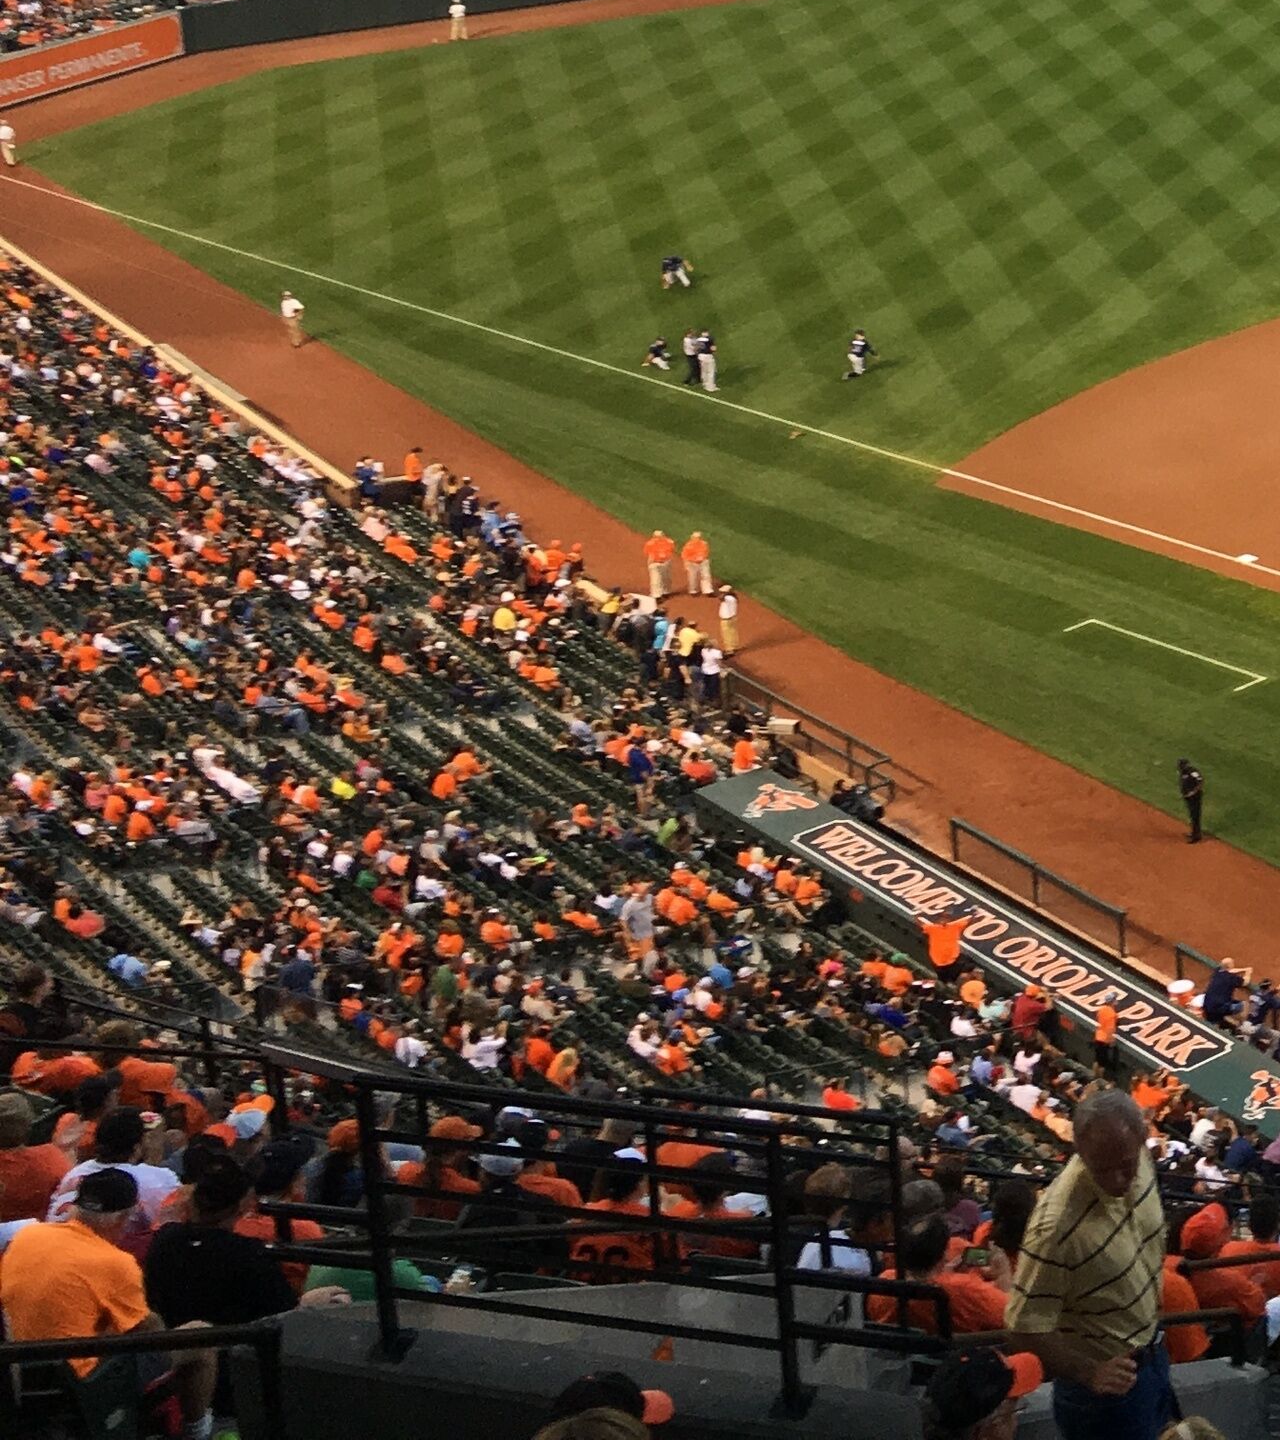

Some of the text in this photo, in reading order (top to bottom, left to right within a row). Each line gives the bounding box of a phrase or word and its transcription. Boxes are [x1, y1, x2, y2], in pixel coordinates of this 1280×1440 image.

[810, 824, 1219, 1066] WELCOME TO ORIOLE PARK
